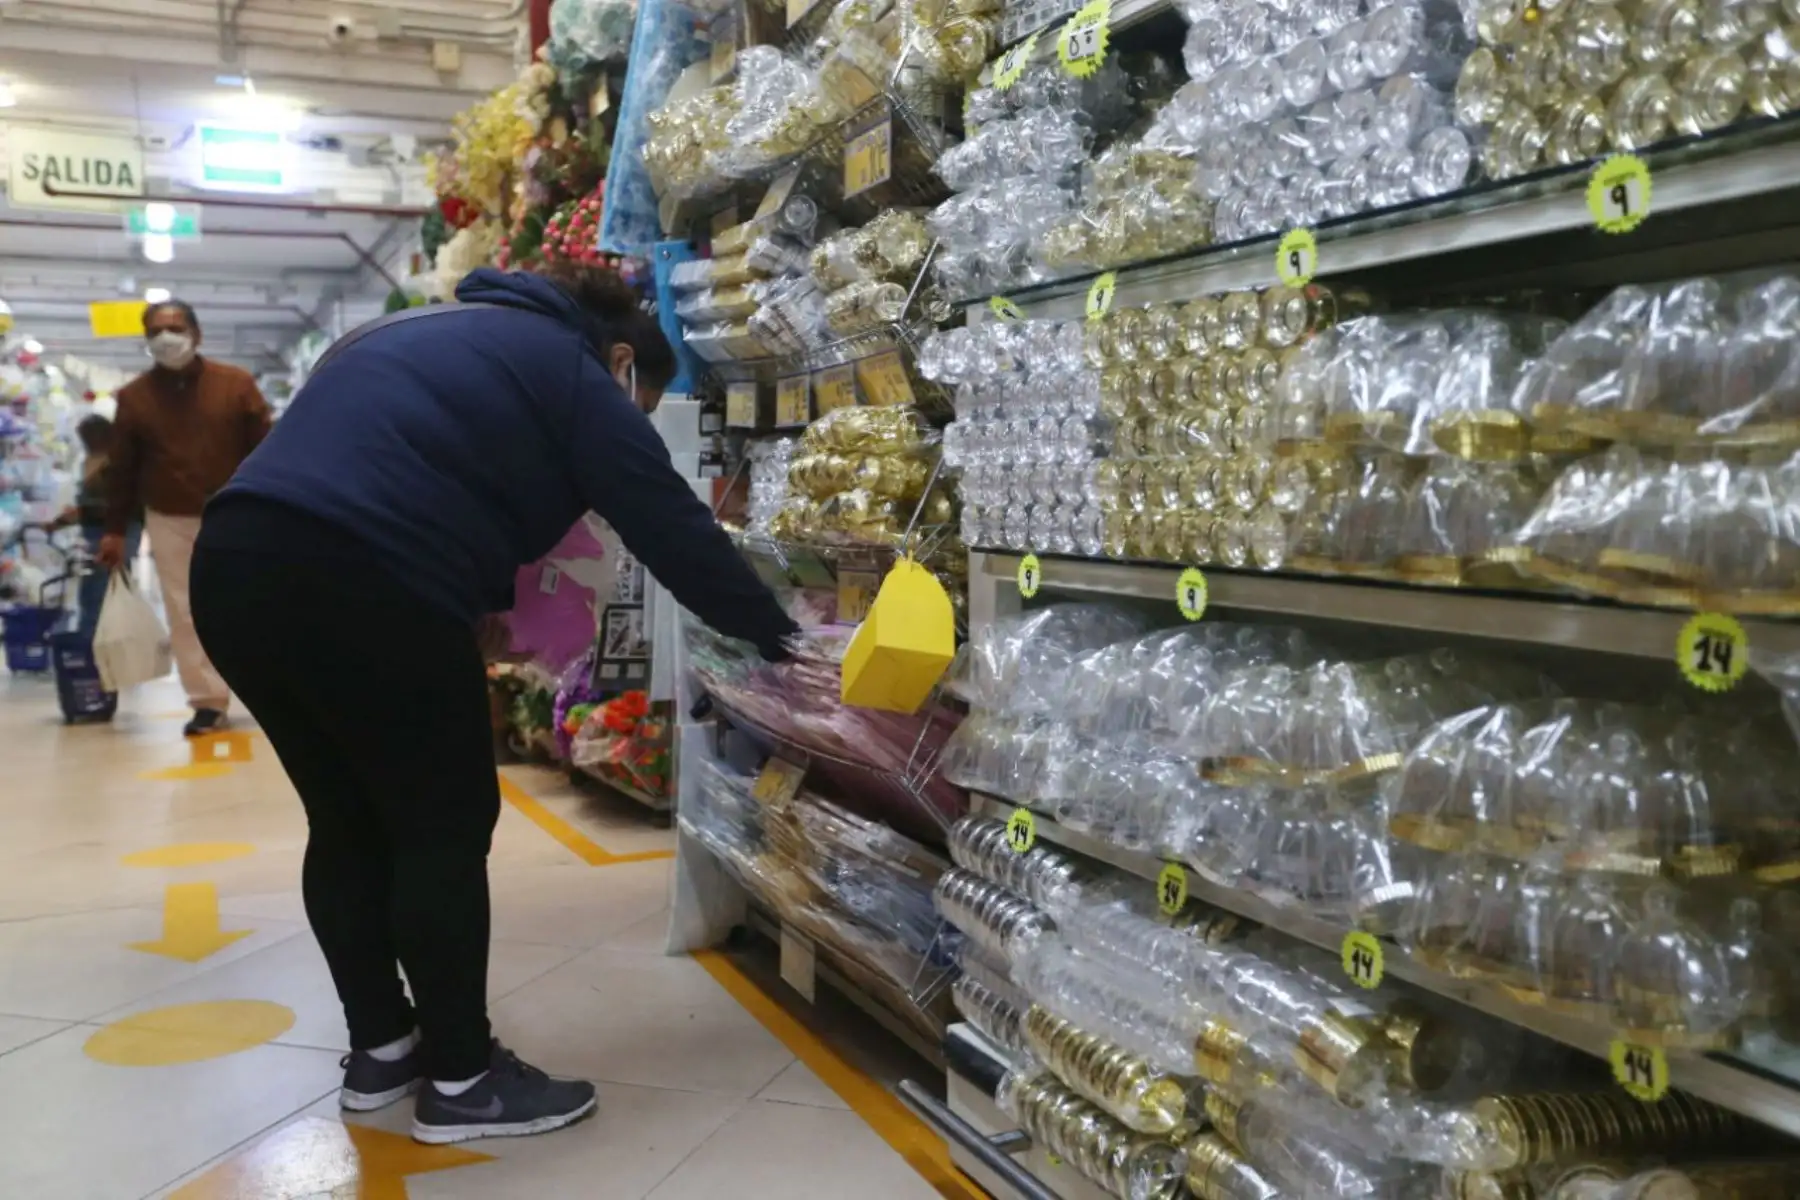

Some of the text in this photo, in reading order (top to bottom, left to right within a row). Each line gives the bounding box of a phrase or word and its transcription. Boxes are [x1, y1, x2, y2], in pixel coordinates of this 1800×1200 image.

[22, 153, 135, 188] SALIDA
[1611, 183, 1629, 217] 9
[1290, 251, 1301, 277] 9
[1096, 289, 1105, 311] 9
[1025, 569, 1032, 590] 9
[1187, 588, 1196, 610] 9
[1693, 635, 1734, 675] 14
[1013, 823, 1028, 845] 14
[1164, 880, 1180, 905] 14
[1351, 949, 1373, 979] 14
[1624, 1050, 1654, 1088] 14
